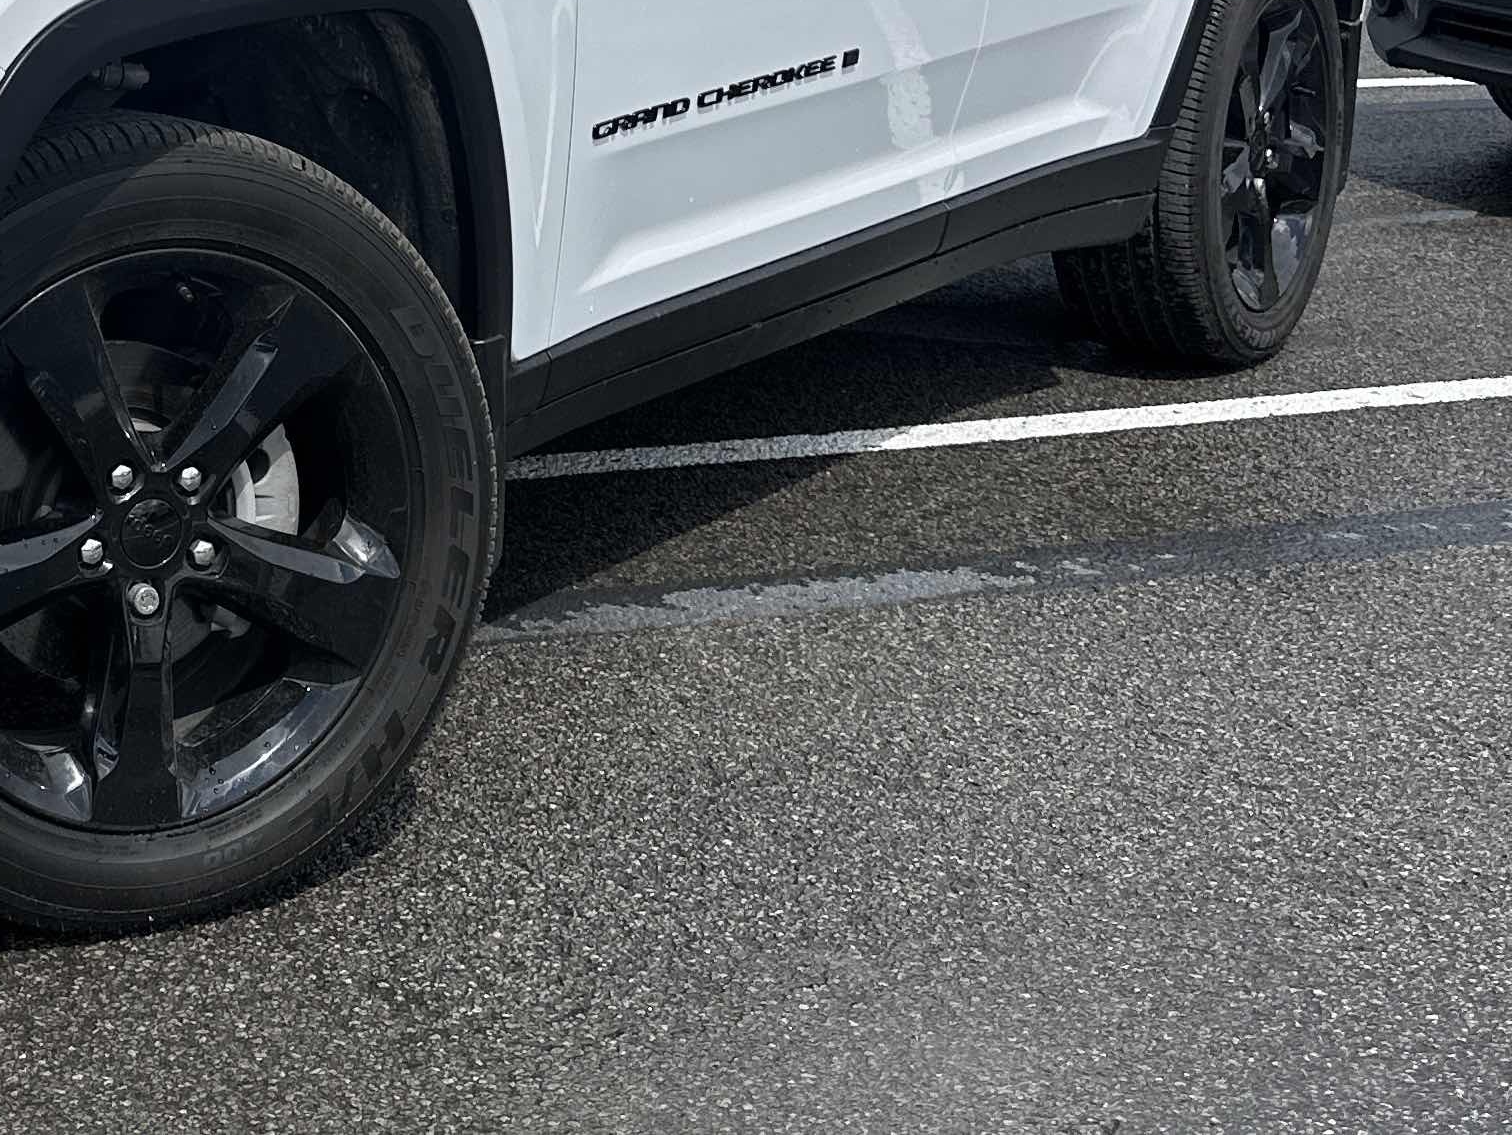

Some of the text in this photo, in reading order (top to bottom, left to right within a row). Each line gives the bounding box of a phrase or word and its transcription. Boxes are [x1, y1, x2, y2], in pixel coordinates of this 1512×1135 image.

[592, 55, 837, 140] GRAND CHEROKEE
[389, 306, 474, 675] DUELER
